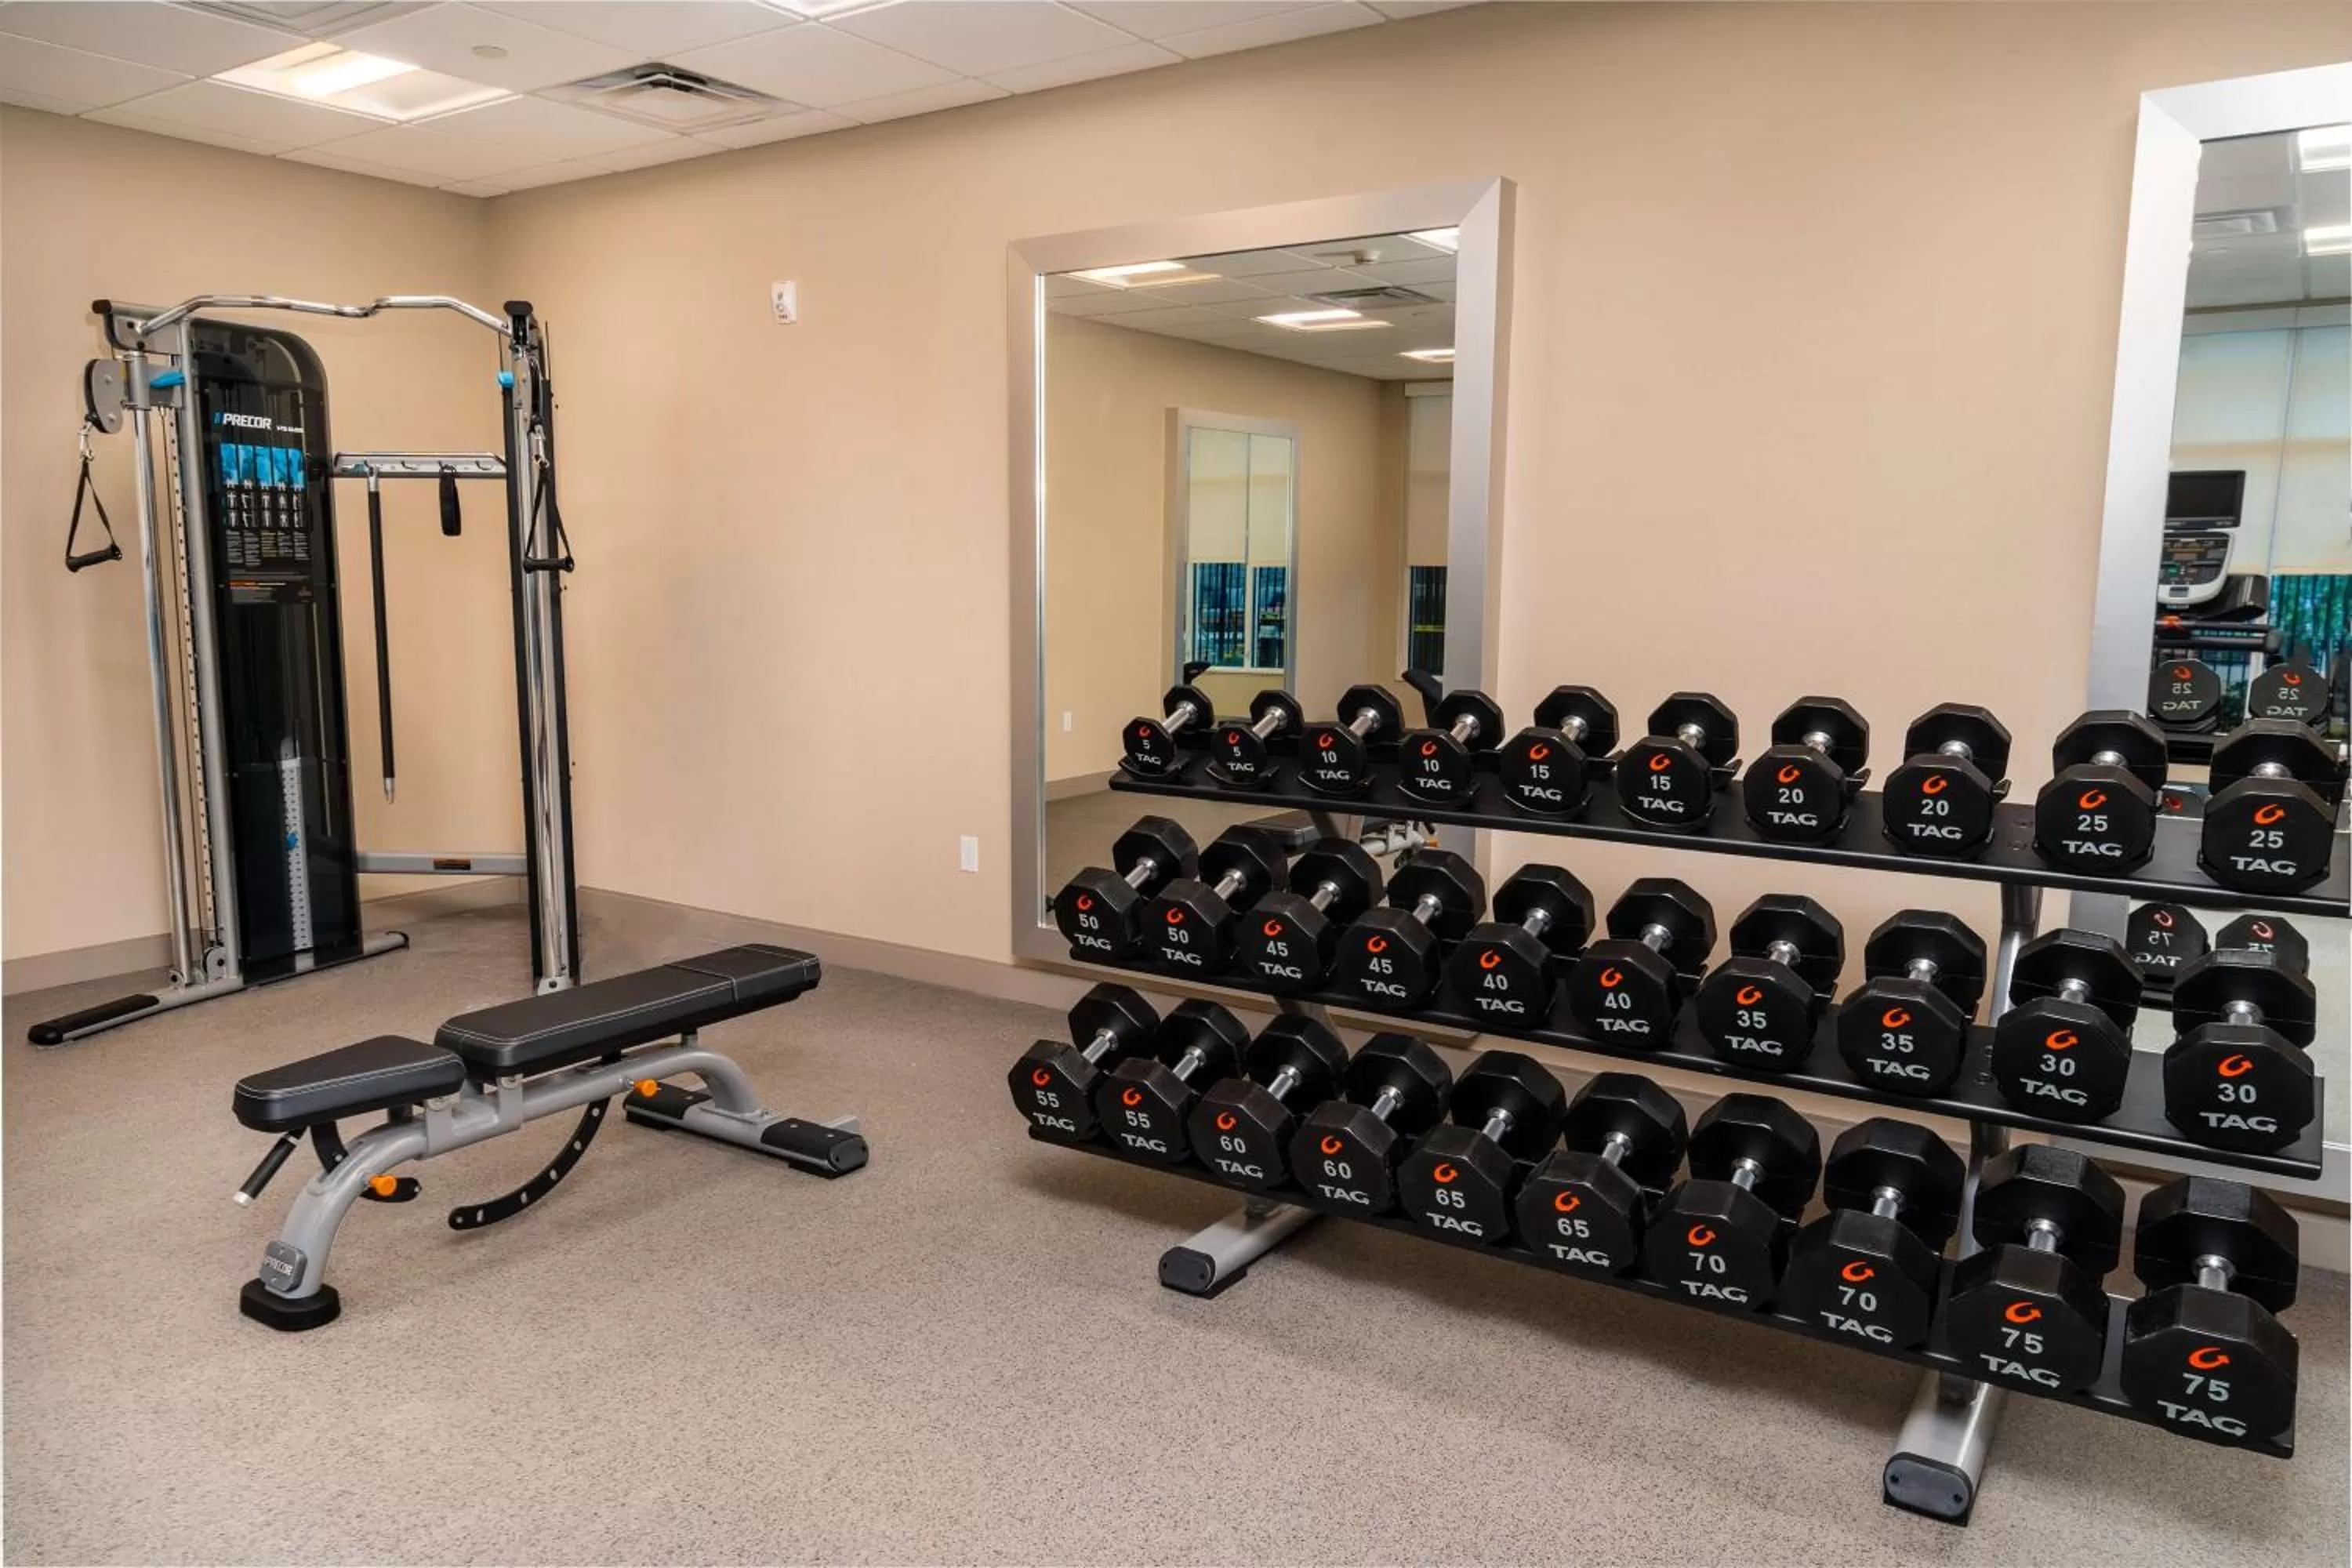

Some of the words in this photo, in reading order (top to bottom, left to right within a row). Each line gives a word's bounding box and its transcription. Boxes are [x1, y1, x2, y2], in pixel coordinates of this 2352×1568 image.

[223, 413, 272, 430] PRECOR
[1143, 740, 1150, 750] 5
[1233, 746, 1241, 757] 5
[1135, 753, 1161, 764] TAG
[1322, 751, 1337, 763] 10
[1424, 759, 1439, 771] 10
[1227, 763, 1254, 771] TAG
[1317, 770, 1349, 780] TAG
[1530, 765, 1549, 779] 15
[1416, 778, 1451, 789] TAG
[1651, 775, 1670, 790] 15
[1519, 785, 1562, 801] TAG
[1779, 788, 1803, 803] 20
[1639, 797, 1684, 813] TAG
[1922, 799, 1949, 815] 20
[1767, 811, 1817, 826] TAG
[2078, 815, 2107, 831] 25
[1907, 823, 1962, 839] TAG
[2249, 830, 2283, 848] 25
[2063, 840, 2122, 856] TAG
[2230, 856, 2296, 875] TAG
[1079, 913, 1098, 929] 50
[1073, 934, 1111, 950] TAG
[1168, 927, 1189, 943] 50
[1162, 948, 1202, 965] TAG
[1267, 941, 1288, 956] 45
[1259, 962, 1301, 978] TAG
[1369, 957, 1392, 974] 45
[1361, 978, 1406, 997] TAG
[1483, 974, 1508, 989] 40
[1475, 998, 1524, 1013] TAG
[1606, 993, 1631, 1008] 40
[1596, 1018, 1650, 1033] TAG
[1737, 1010, 1766, 1029] 35
[1725, 1035, 1783, 1055] TAG
[1882, 1033, 1915, 1052] 35
[1867, 1058, 1930, 1080] TAG
[2040, 1054, 2074, 1076] 30
[1036, 1090, 1059, 1107] 55
[2020, 1079, 2087, 1105] TAG
[2219, 1083, 2256, 1103] 30
[1033, 1112, 1075, 1131] TAG
[1126, 1110, 1150, 1128] 55
[2199, 1112, 2277, 1132] TAG
[1121, 1134, 1167, 1152] TAG
[1221, 1136, 1246, 1153] 60
[1215, 1159, 1263, 1179] TAG
[1324, 1160, 1352, 1179] 60
[1318, 1185, 1370, 1204] TAG
[1436, 1189, 1465, 1208] 65
[1427, 1212, 1483, 1236] TAG
[1558, 1218, 1589, 1237] 65
[1548, 1244, 1610, 1266] TAG
[1689, 1252, 1726, 1273] 70
[1681, 1281, 1748, 1303] TAG
[1838, 1286, 1877, 1311] 70
[1820, 1311, 1893, 1343] TAG
[2002, 1327, 2043, 1353] 75
[1980, 1354, 2060, 1389] TAG
[2183, 1373, 2230, 1401] 75
[2158, 1400, 2248, 1438] TAG
